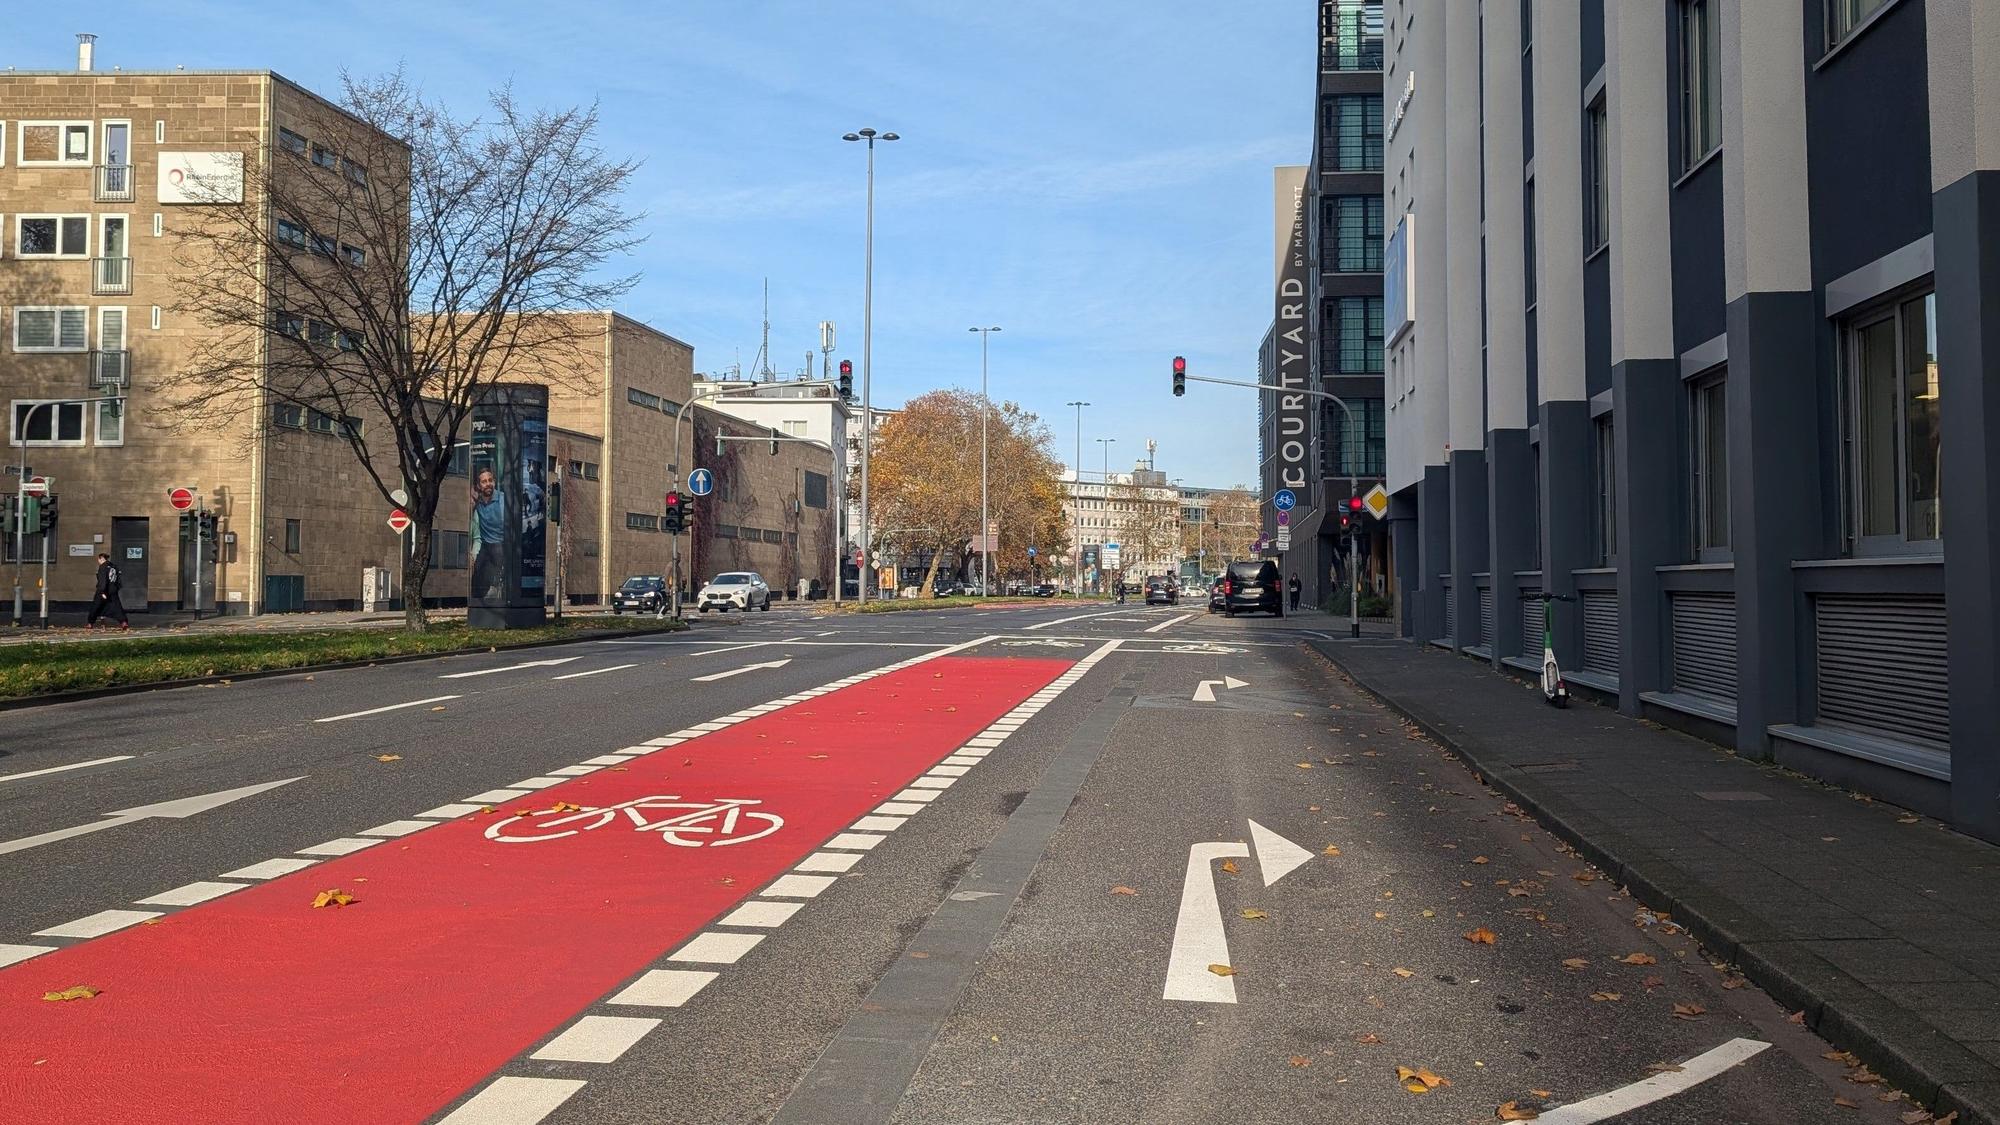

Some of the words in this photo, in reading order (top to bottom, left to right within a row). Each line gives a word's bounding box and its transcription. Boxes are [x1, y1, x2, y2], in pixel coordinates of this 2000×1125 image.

[1294, 185, 1303, 247] MARRIOTT
[1294, 253, 1303, 267] BY
[1281, 278, 1304, 482] COURTYARD
